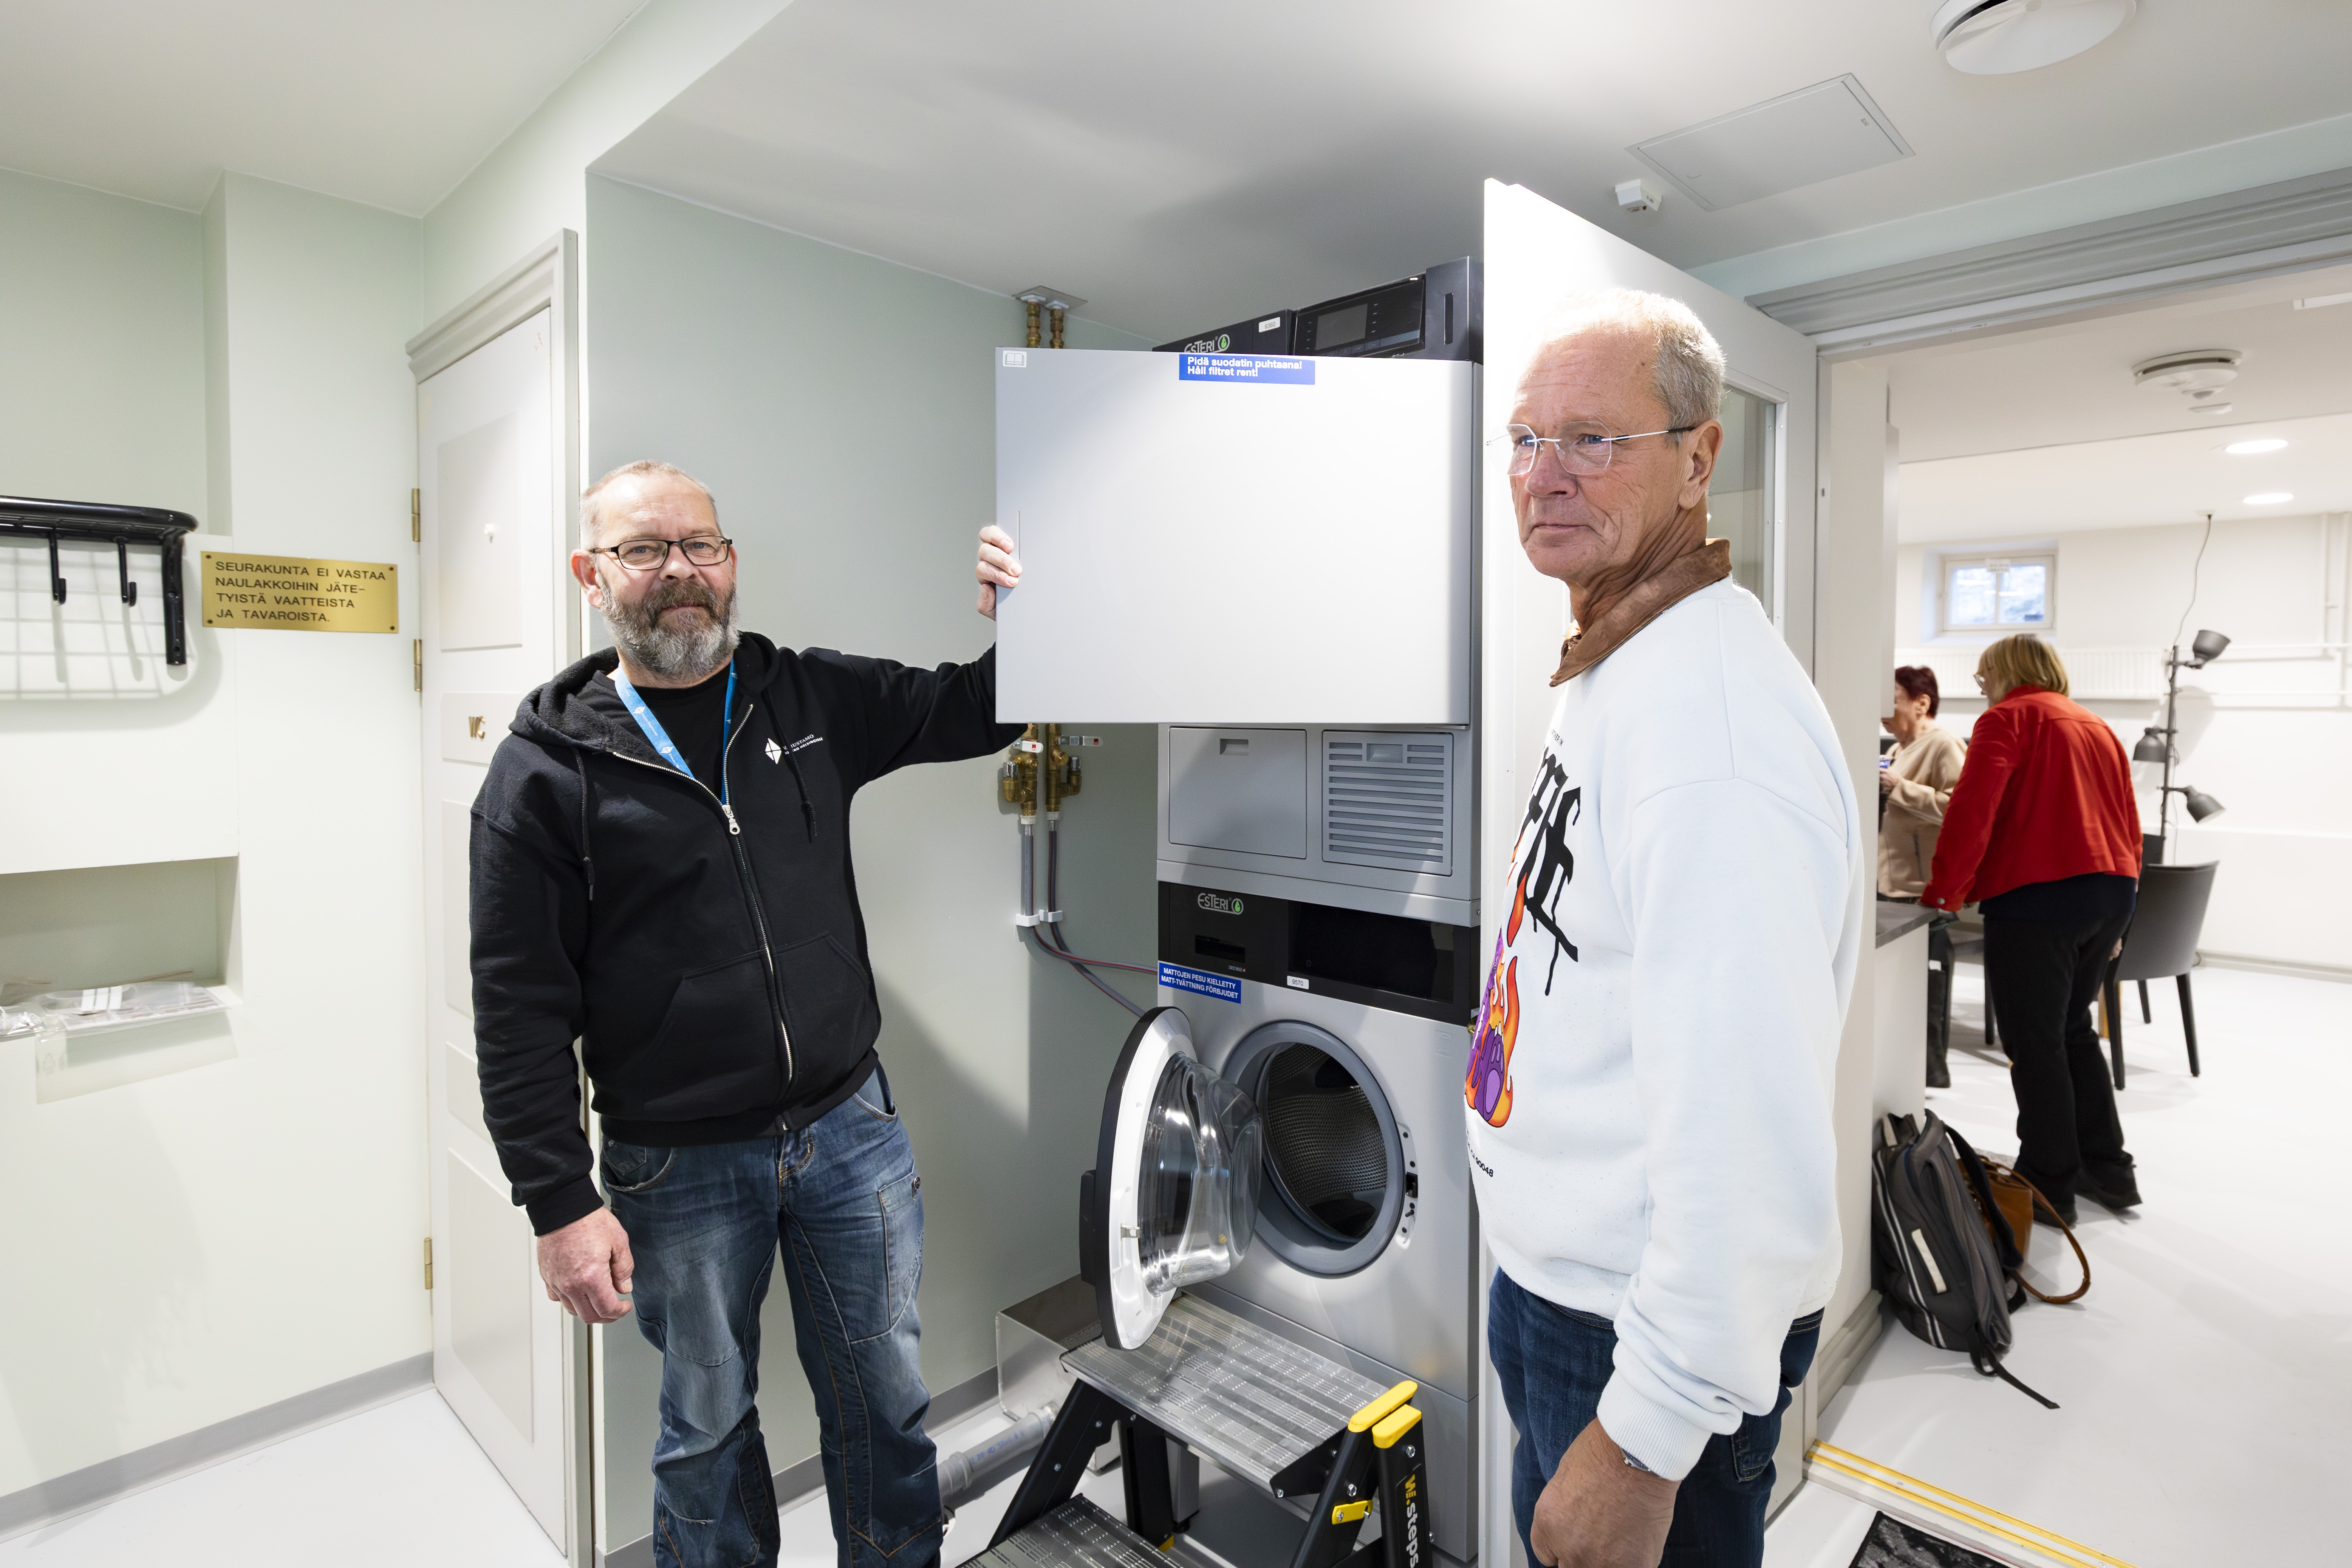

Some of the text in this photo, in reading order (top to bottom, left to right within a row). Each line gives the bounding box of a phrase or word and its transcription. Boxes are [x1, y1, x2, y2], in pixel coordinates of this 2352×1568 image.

[1187, 365, 1258, 377] Håll filtret rent!
[1188, 356, 1302, 370] Pidä suodatin puhtaana!
[215, 561, 386, 580] SEURAKUNTA EI VASTAA
[215, 577, 365, 593] NAULAKKOIHIN JÄTE-
[216, 592, 354, 608] TYISTÄ VAATTEISTA
[216, 609, 330, 622] JA TAVAROISTA.
[468, 716, 486, 739] WC
[783, 734, 814, 750] VRUSTAMO
[1164, 967, 1236, 989] MATTOJEN PESU KIELLETTY
[1161, 975, 1238, 999] MATT-TVÄTTNING FÖRBJUDET
[1476, 1157, 1493, 1177] 90048
